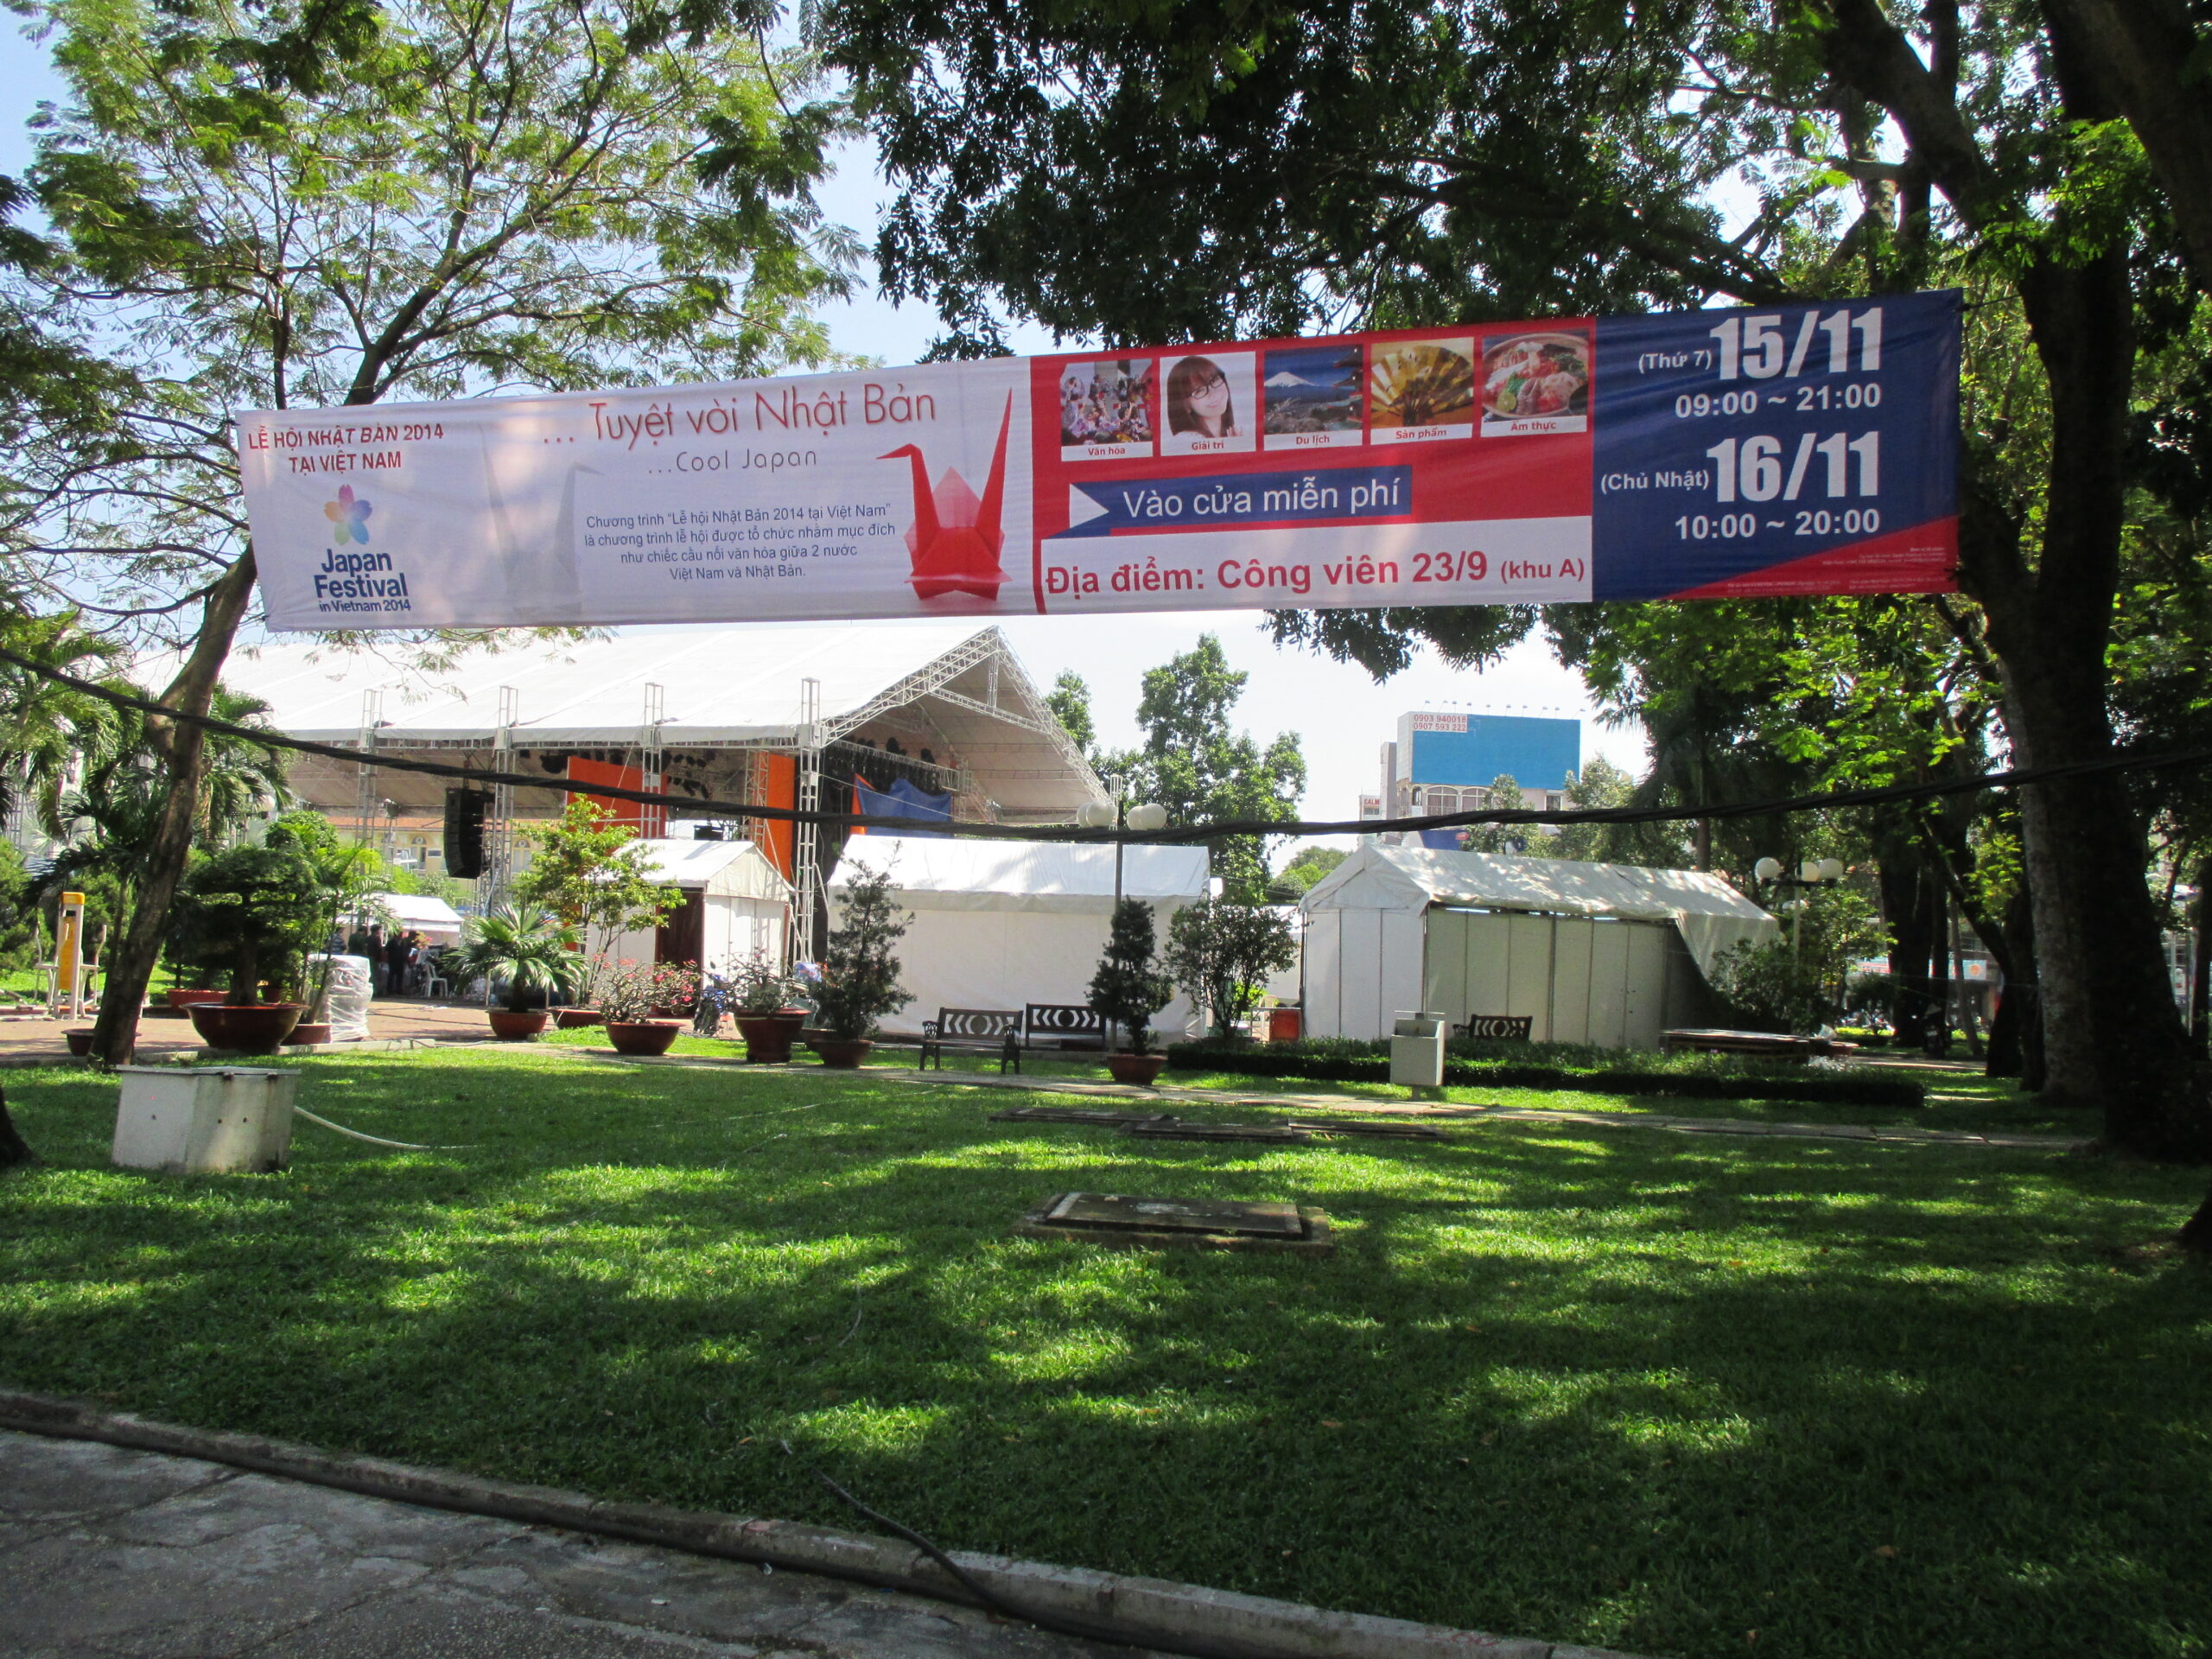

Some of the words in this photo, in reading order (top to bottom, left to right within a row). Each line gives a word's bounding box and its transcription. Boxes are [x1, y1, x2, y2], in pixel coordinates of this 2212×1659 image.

[1709, 307, 1883, 380] 15/11
[1638, 351, 1688, 374] (Thứ
[1693, 349, 1713, 371] 7)
[1675, 390, 1758, 418] 09:00
[1796, 383, 1881, 412] 21:00
[588, 402, 673, 451] Tuyệt
[755, 385, 847, 436] Nhật
[864, 383, 936, 424] Bản
[248, 424, 269, 449] LỄ
[274, 427, 302, 451] HỘI
[308, 424, 356, 448] NHẬT
[403, 423, 444, 441] 2014
[1296, 436, 1309, 445] Du
[1313, 435, 1330, 446] lịch
[289, 455, 315, 476] TẠI
[319, 449, 357, 474] VIỆT
[362, 451, 402, 469] NAM
[742, 448, 817, 474] Japan
[1707, 431, 1879, 503] 16/11
[1600, 471, 1648, 494] (Chủ
[1655, 469, 1709, 493] Nhật)
[1123, 489, 1183, 518] Vào
[1193, 485, 1251, 515] cửa
[1263, 476, 1338, 512] miễn
[1351, 477, 1401, 514] phí
[638, 513, 664, 526] trình
[691, 512, 709, 527] hội
[712, 510, 741, 526] Nhật
[745, 508, 769, 522] Bản
[773, 507, 804, 520] 2014
[809, 506, 823, 521] tại
[827, 505, 851, 520] Việt
[1675, 513, 1756, 539] 10:00
[1795, 508, 1879, 536] 20:00
[584, 534, 594, 547] là
[646, 531, 673, 544] trình
[677, 529, 687, 543] lễ
[690, 530, 709, 544] hội
[712, 530, 745, 543] được
[763, 527, 794, 540] chức
[837, 526, 864, 540] mục
[321, 549, 393, 578] Japan
[620, 551, 644, 563] như
[647, 548, 677, 563] chiếc
[728, 549, 749, 560] văn
[779, 545, 808, 562] giữa
[811, 544, 820, 557] 2
[823, 543, 857, 556] nước
[314, 572, 409, 598] Festival
[669, 568, 693, 582] Việt
[696, 567, 724, 580] Nam
[746, 565, 774, 580] Nhật
[1045, 566, 1099, 600] Địa
[1110, 556, 1205, 593] điểm:
[1217, 558, 1311, 594] Công
[1322, 554, 1399, 585] viên
[1412, 550, 1488, 582] 23/9
[1501, 560, 1552, 584] (khu
[1559, 558, 1585, 582] A)
[319, 600, 331, 612] in
[331, 600, 382, 612] Vietnam
[383, 599, 411, 611] 2014
[1452, 723, 1465, 732] 222
